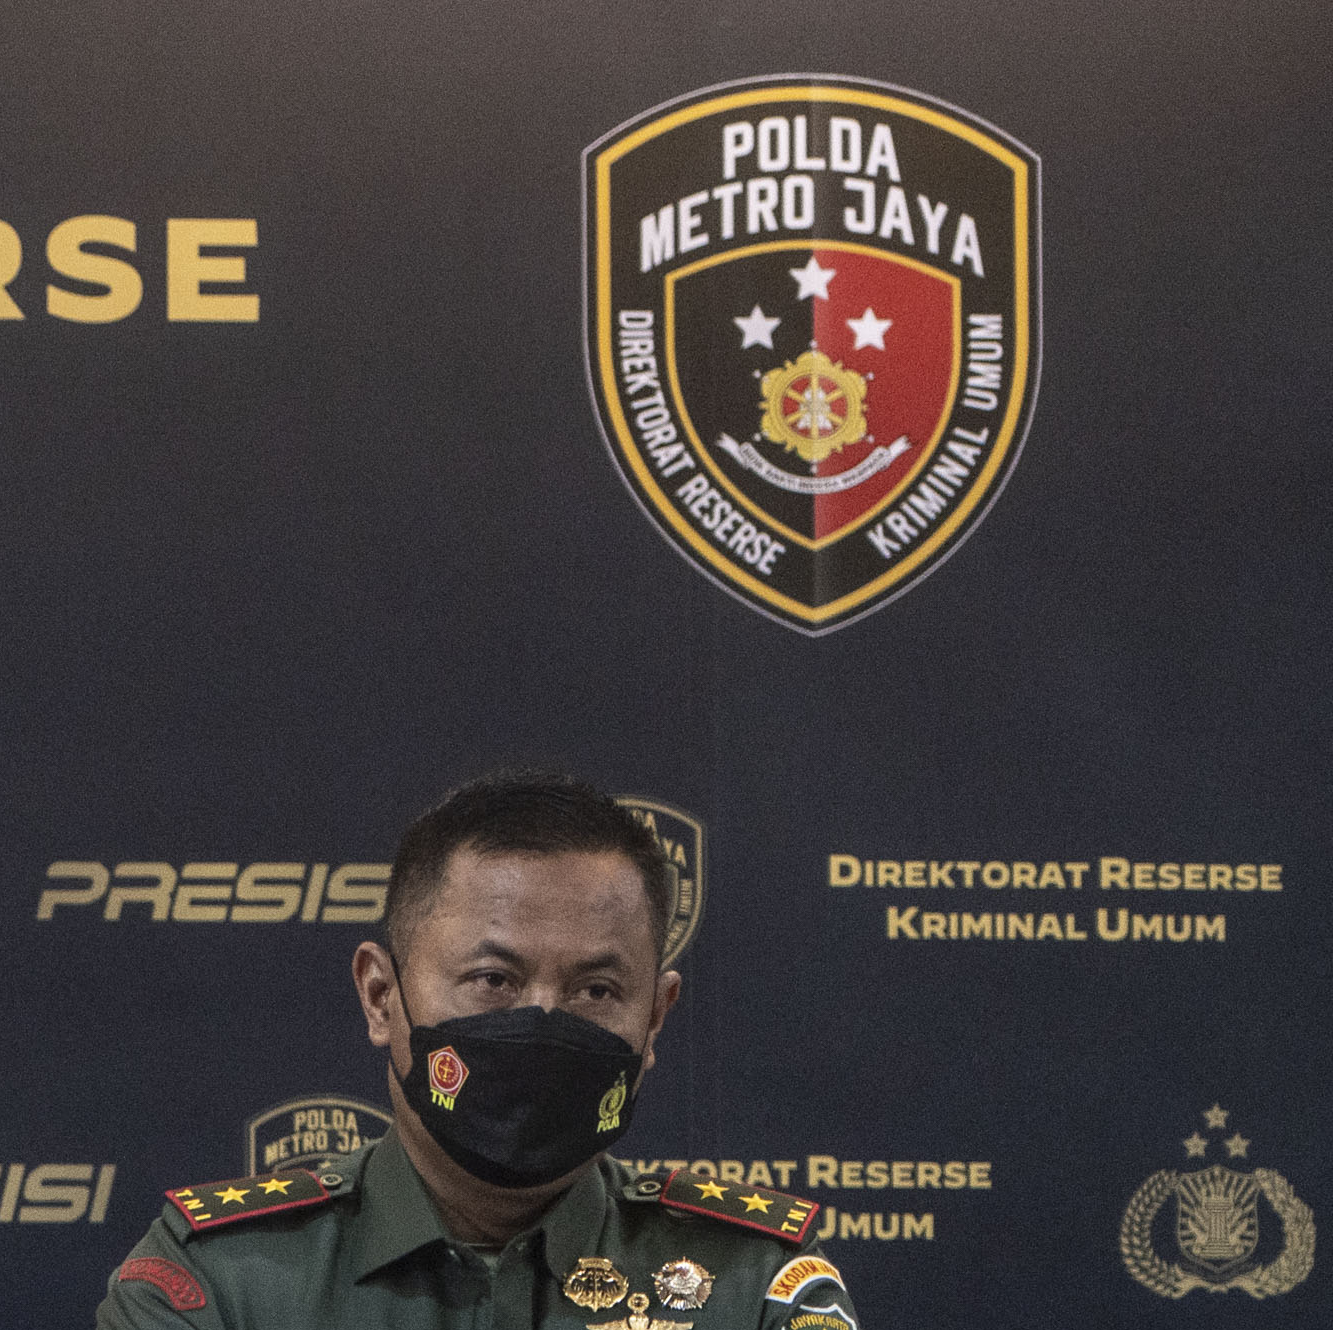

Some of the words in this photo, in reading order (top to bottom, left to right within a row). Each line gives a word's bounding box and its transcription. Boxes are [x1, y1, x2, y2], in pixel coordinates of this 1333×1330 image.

[722, 115, 901, 182] POLDA
[639, 174, 815, 273] METRO
[843, 177, 985, 278] JAYA
[618, 309, 693, 478] DIREKTORAT
[676, 473, 787, 576] RESERSE
[867, 426, 990, 558] KRIMINAL
[964, 313, 1003, 412] UMUM
[828, 854, 1090, 889] DIREKTORAT
[1099, 856, 1283, 891] RESERSE
[36, 861, 394, 922] PRESIS
[886, 906, 1087, 940] KRIMINAL
[1096, 908, 1226, 942] UMUM
[430, 1088, 455, 1111] TNI
[294, 1110, 358, 1133] POLDA
[264, 1131, 329, 1167] METRO
[807, 1155, 992, 1189] RESERSE
[175, 1188, 212, 1222] TNI
[781, 1201, 813, 1233] TNI
